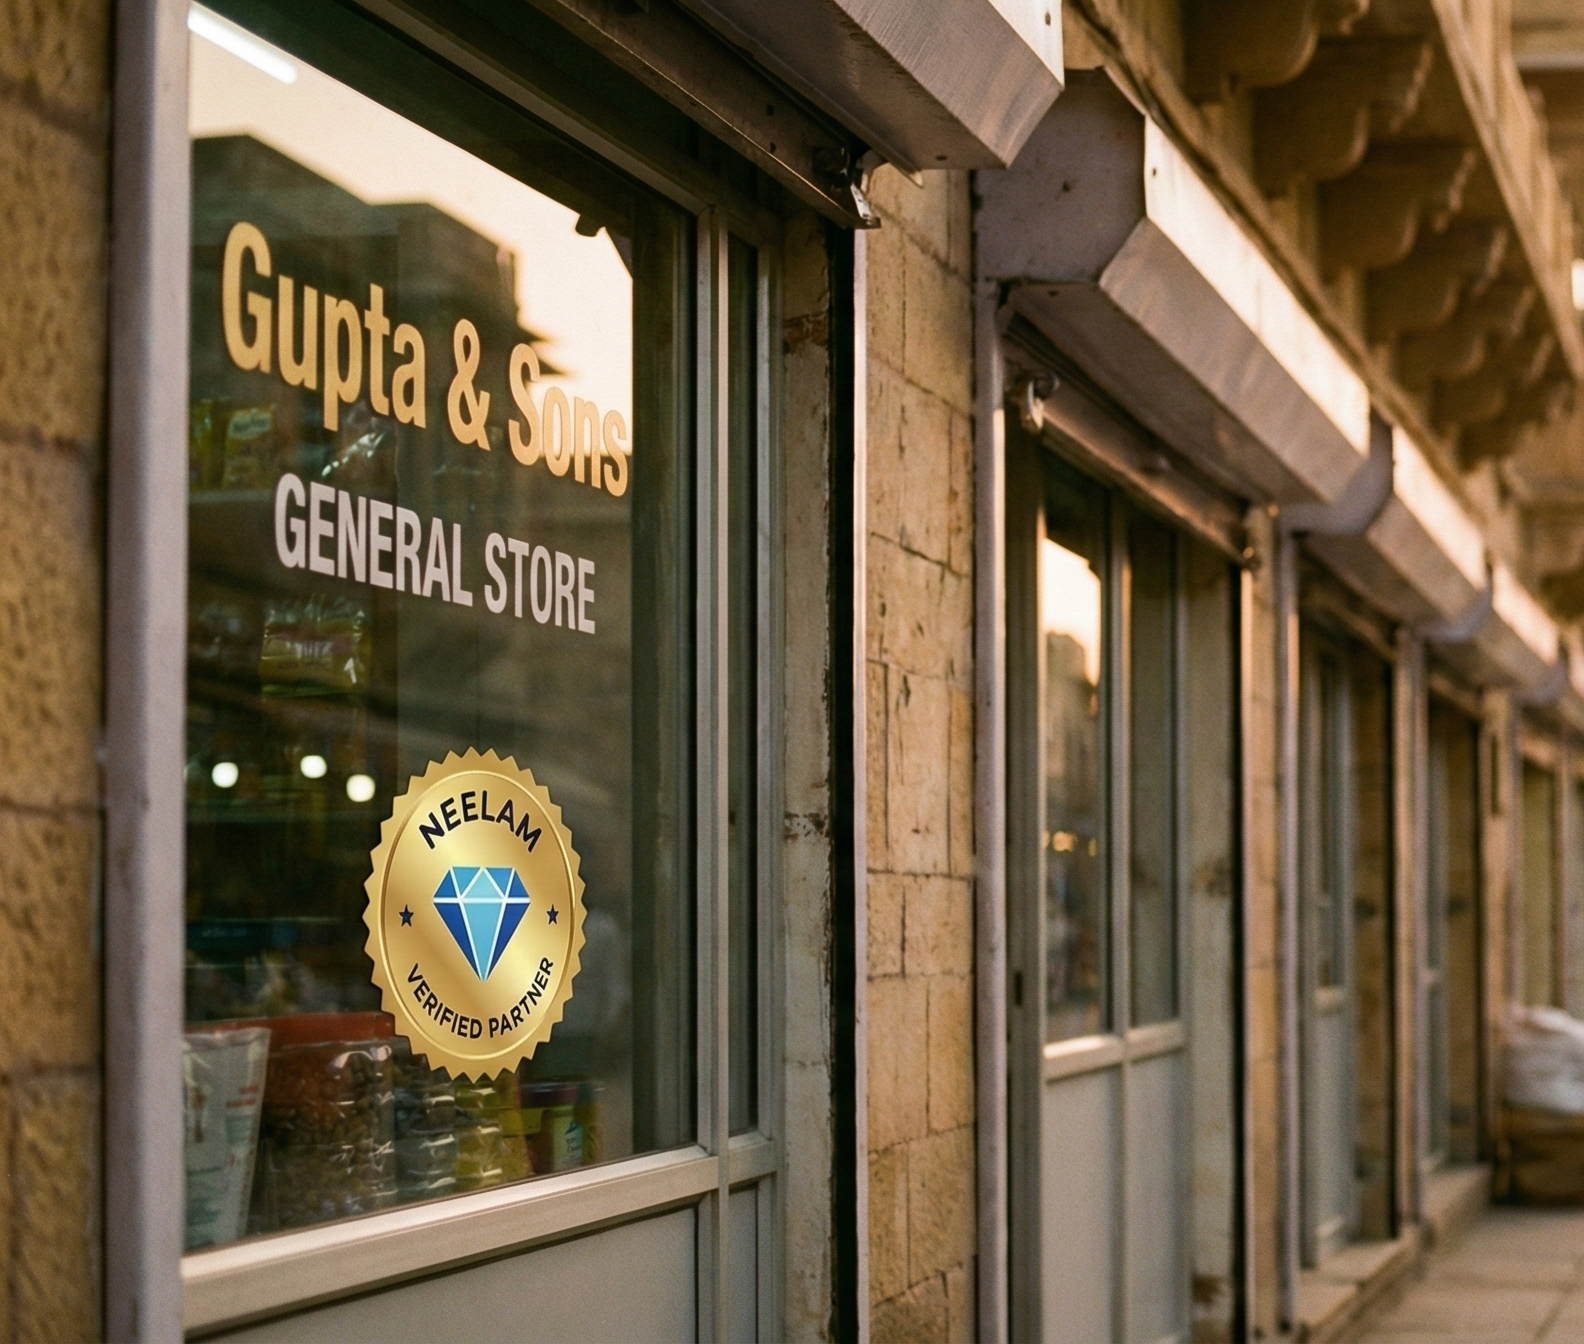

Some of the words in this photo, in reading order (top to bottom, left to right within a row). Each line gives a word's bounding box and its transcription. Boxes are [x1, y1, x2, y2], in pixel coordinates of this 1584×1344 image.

[222, 221, 427, 430] Gupta
[447, 318, 491, 451] &
[508, 343, 629, 497] Sons
[275, 473, 473, 607] GENERAL
[484, 533, 596, 635] STORE
[418, 790, 542, 853] NEELAM
[407, 963, 483, 1040] VERIFIED
[488, 957, 554, 1039] PARTNER
